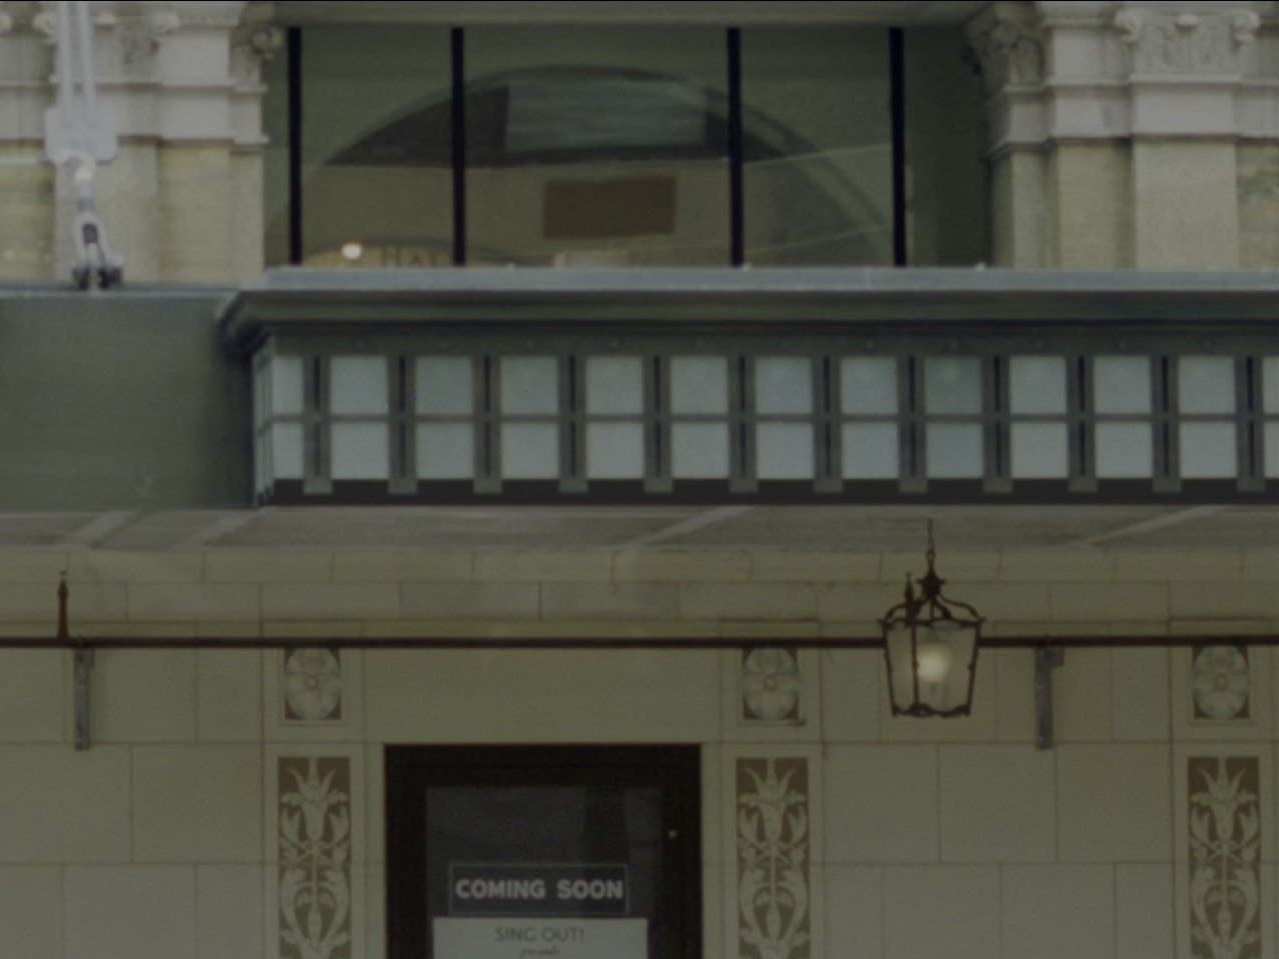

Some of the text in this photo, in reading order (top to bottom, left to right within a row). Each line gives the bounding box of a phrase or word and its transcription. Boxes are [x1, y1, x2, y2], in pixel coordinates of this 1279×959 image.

[455, 879, 623, 900] COMING SOON
[495, 927, 585, 942] SING OUT!
